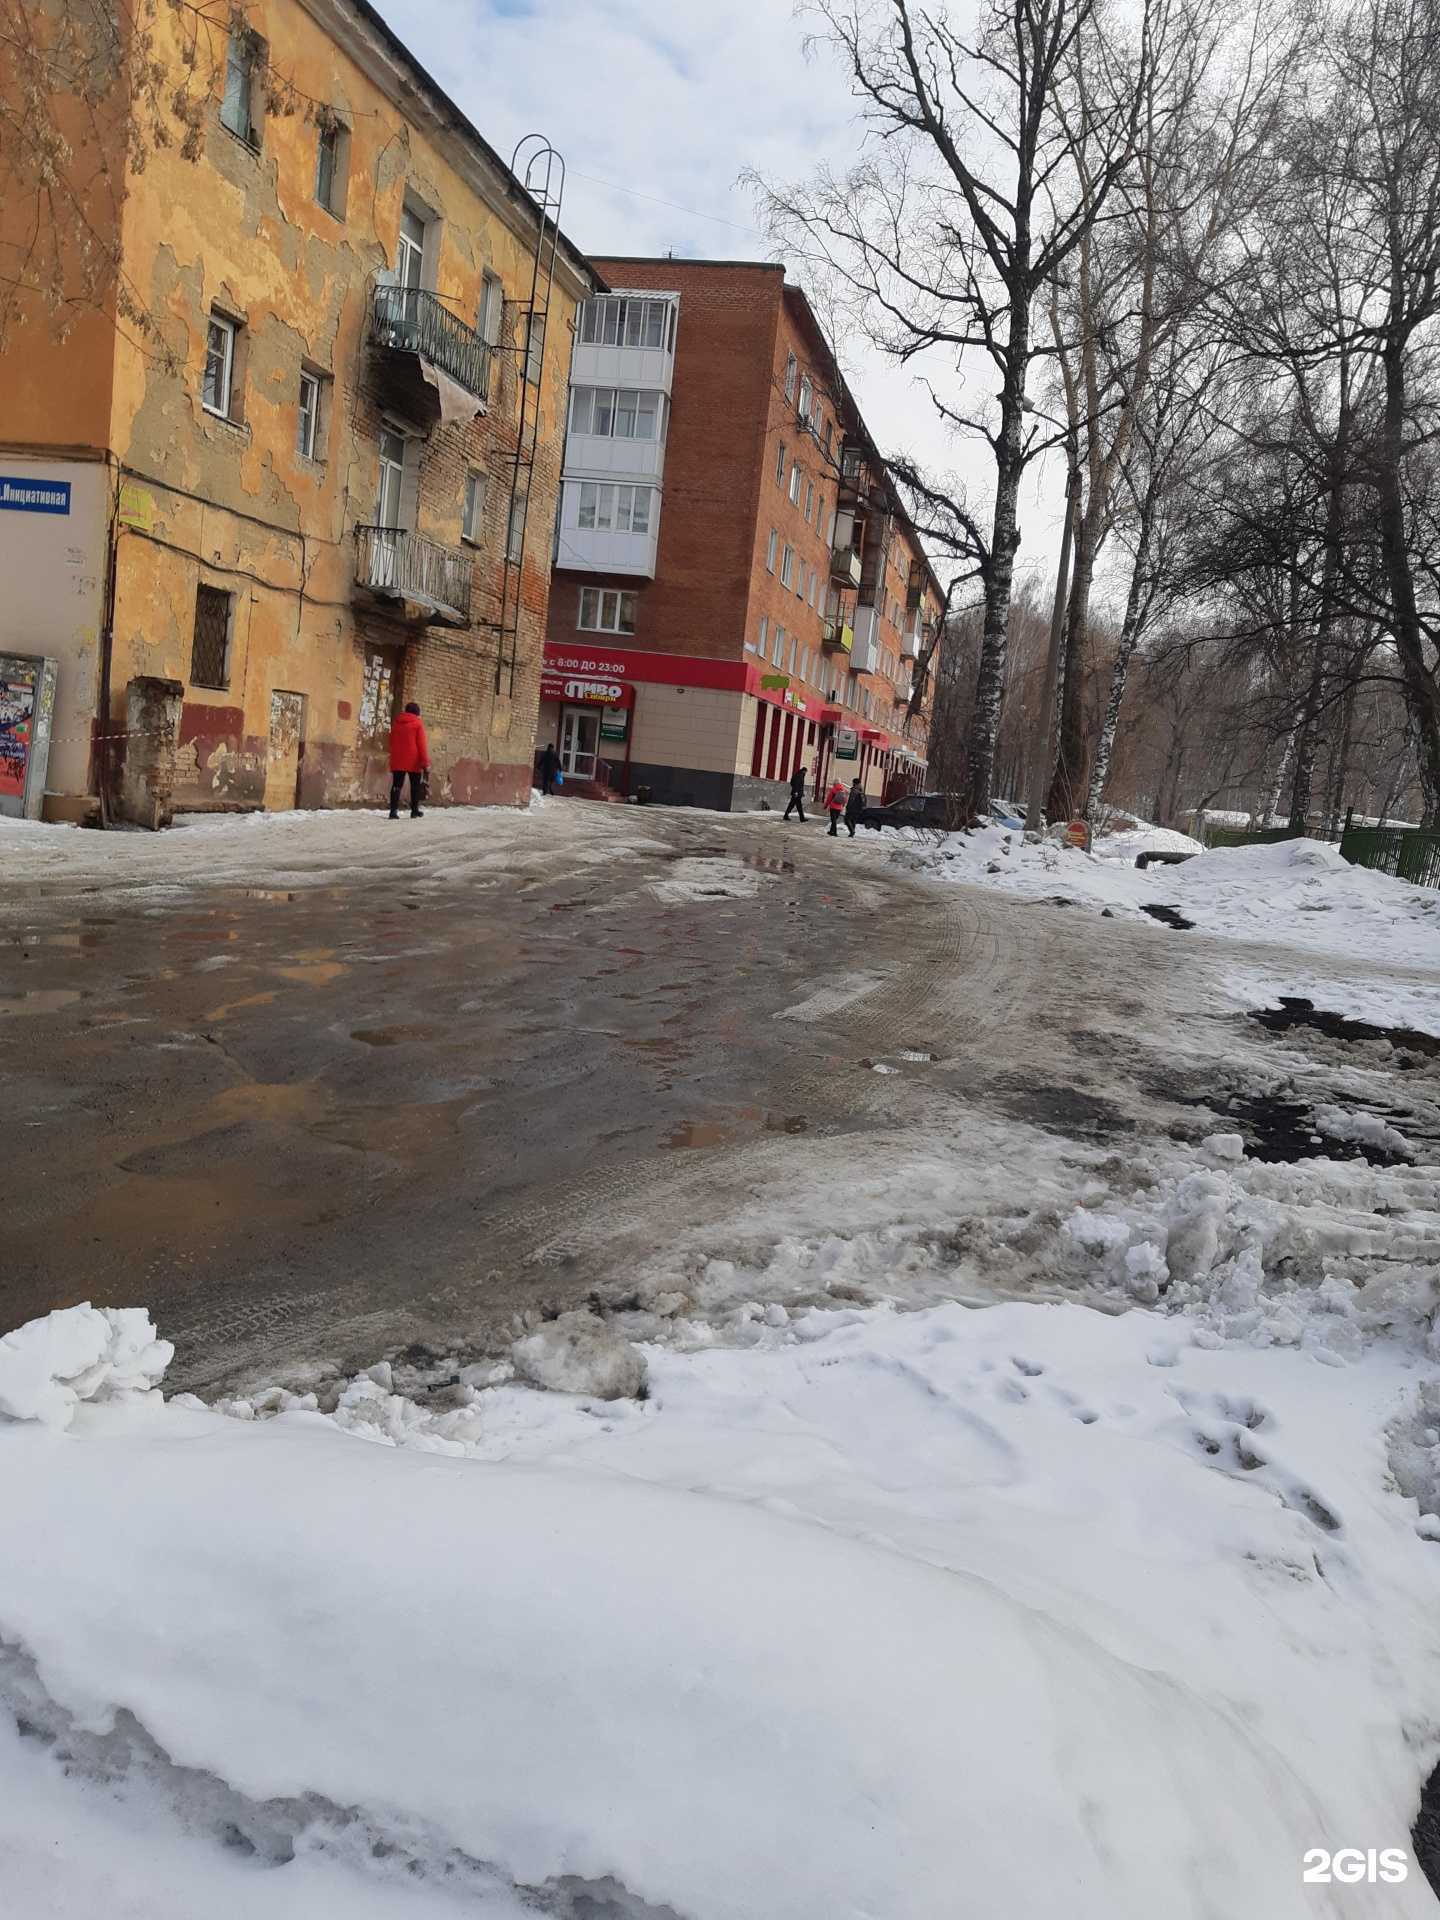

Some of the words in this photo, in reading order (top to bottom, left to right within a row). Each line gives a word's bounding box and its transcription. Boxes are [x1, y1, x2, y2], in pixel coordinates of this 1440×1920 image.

[0, 483, 67, 505] .Инициативная
[558, 658, 578, 668] 8:00
[581, 661, 596, 671] ДО
[599, 663, 625, 673] 23:00
